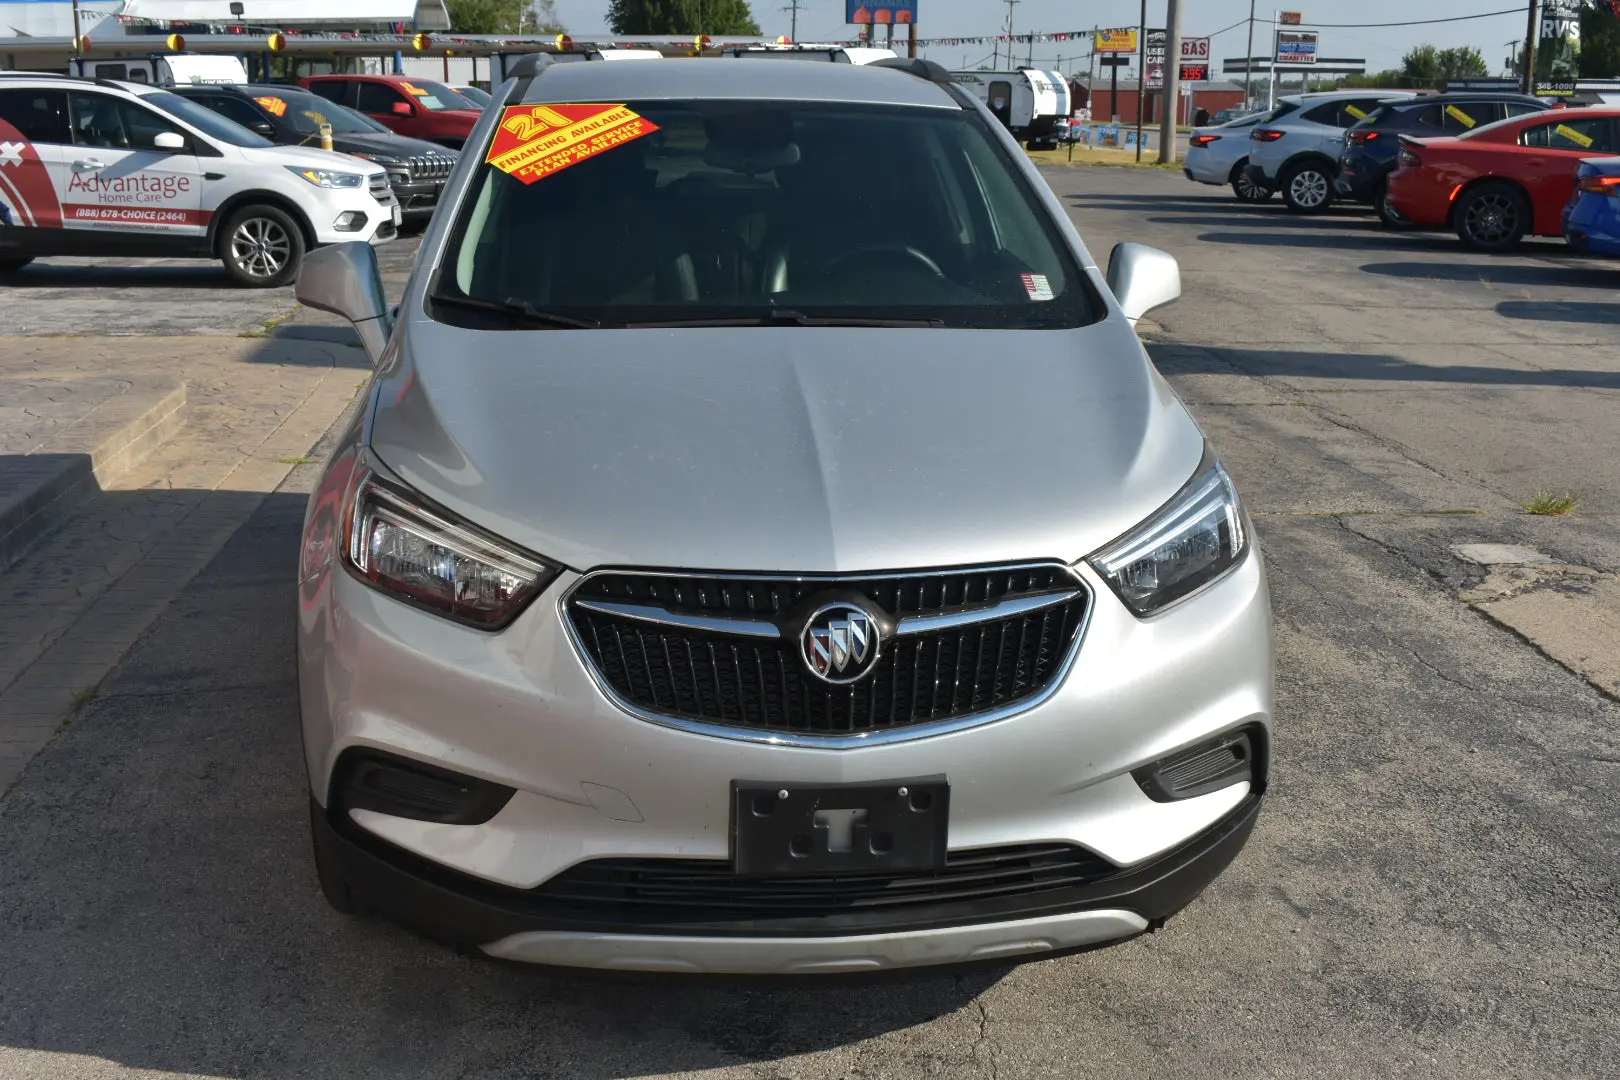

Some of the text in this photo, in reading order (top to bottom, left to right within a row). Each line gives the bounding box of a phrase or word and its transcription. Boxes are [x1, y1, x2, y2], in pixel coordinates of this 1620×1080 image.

[1541, 19, 1580, 39] RV'S
[1181, 42, 1207, 56] GAS
[502, 106, 574, 141] 21
[499, 109, 632, 169] FINANCING AVAILABLE
[519, 120, 643, 176] EXTENDED SERVICE
[535, 128, 642, 177] PLAN AVAILABLE
[68, 172, 190, 199] Advantage
[98, 193, 162, 203] Home Care
[75, 208, 187, 222] (888) 678-CHOICE (2464)
